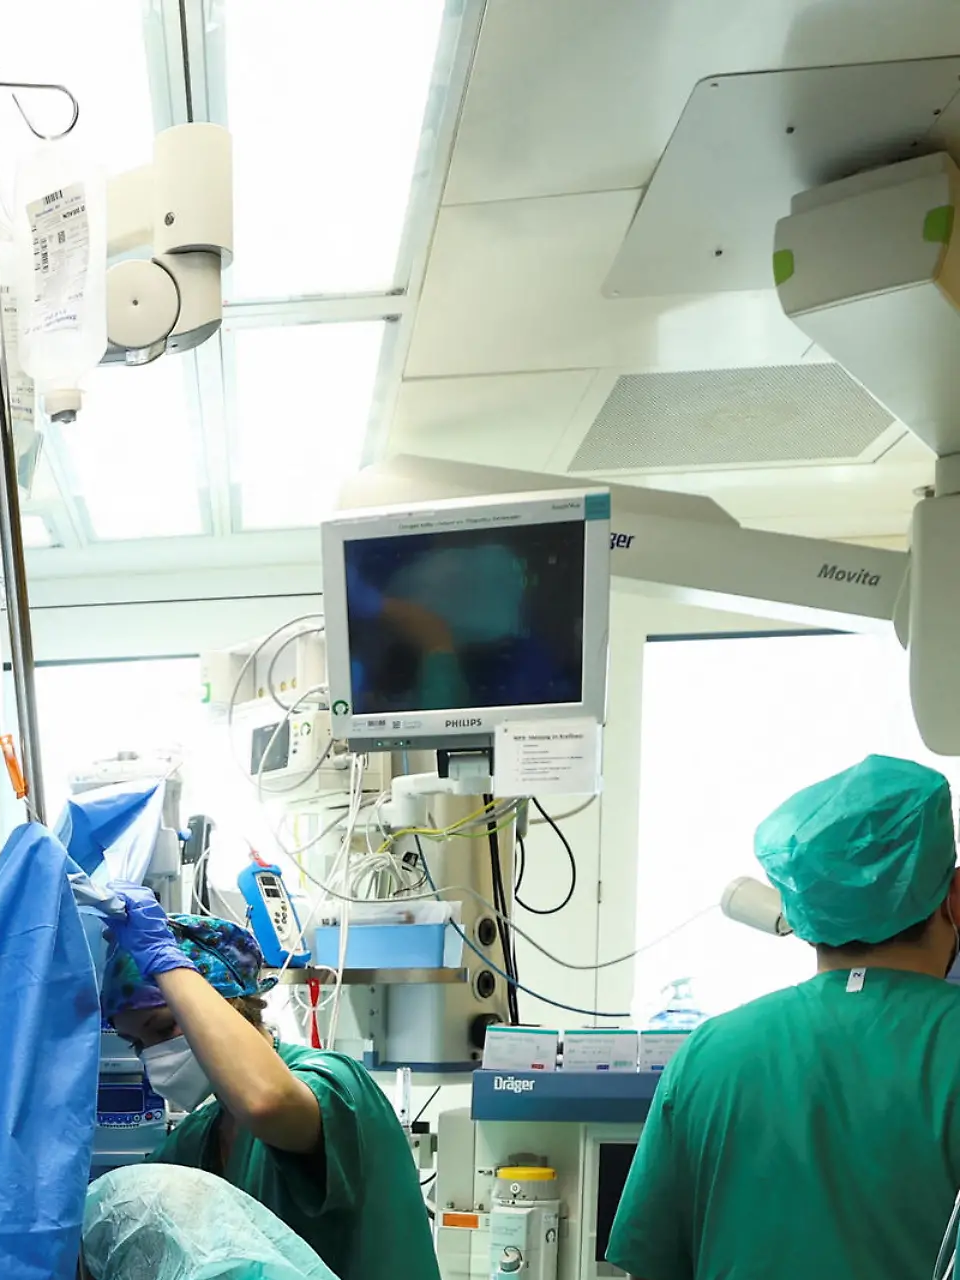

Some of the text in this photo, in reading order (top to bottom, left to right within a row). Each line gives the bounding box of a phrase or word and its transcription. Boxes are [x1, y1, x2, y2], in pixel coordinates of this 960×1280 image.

[816, 563, 881, 587] Movita
[444, 718, 483, 729] PHILIPS
[494, 1076, 536, 1094] Dräger
